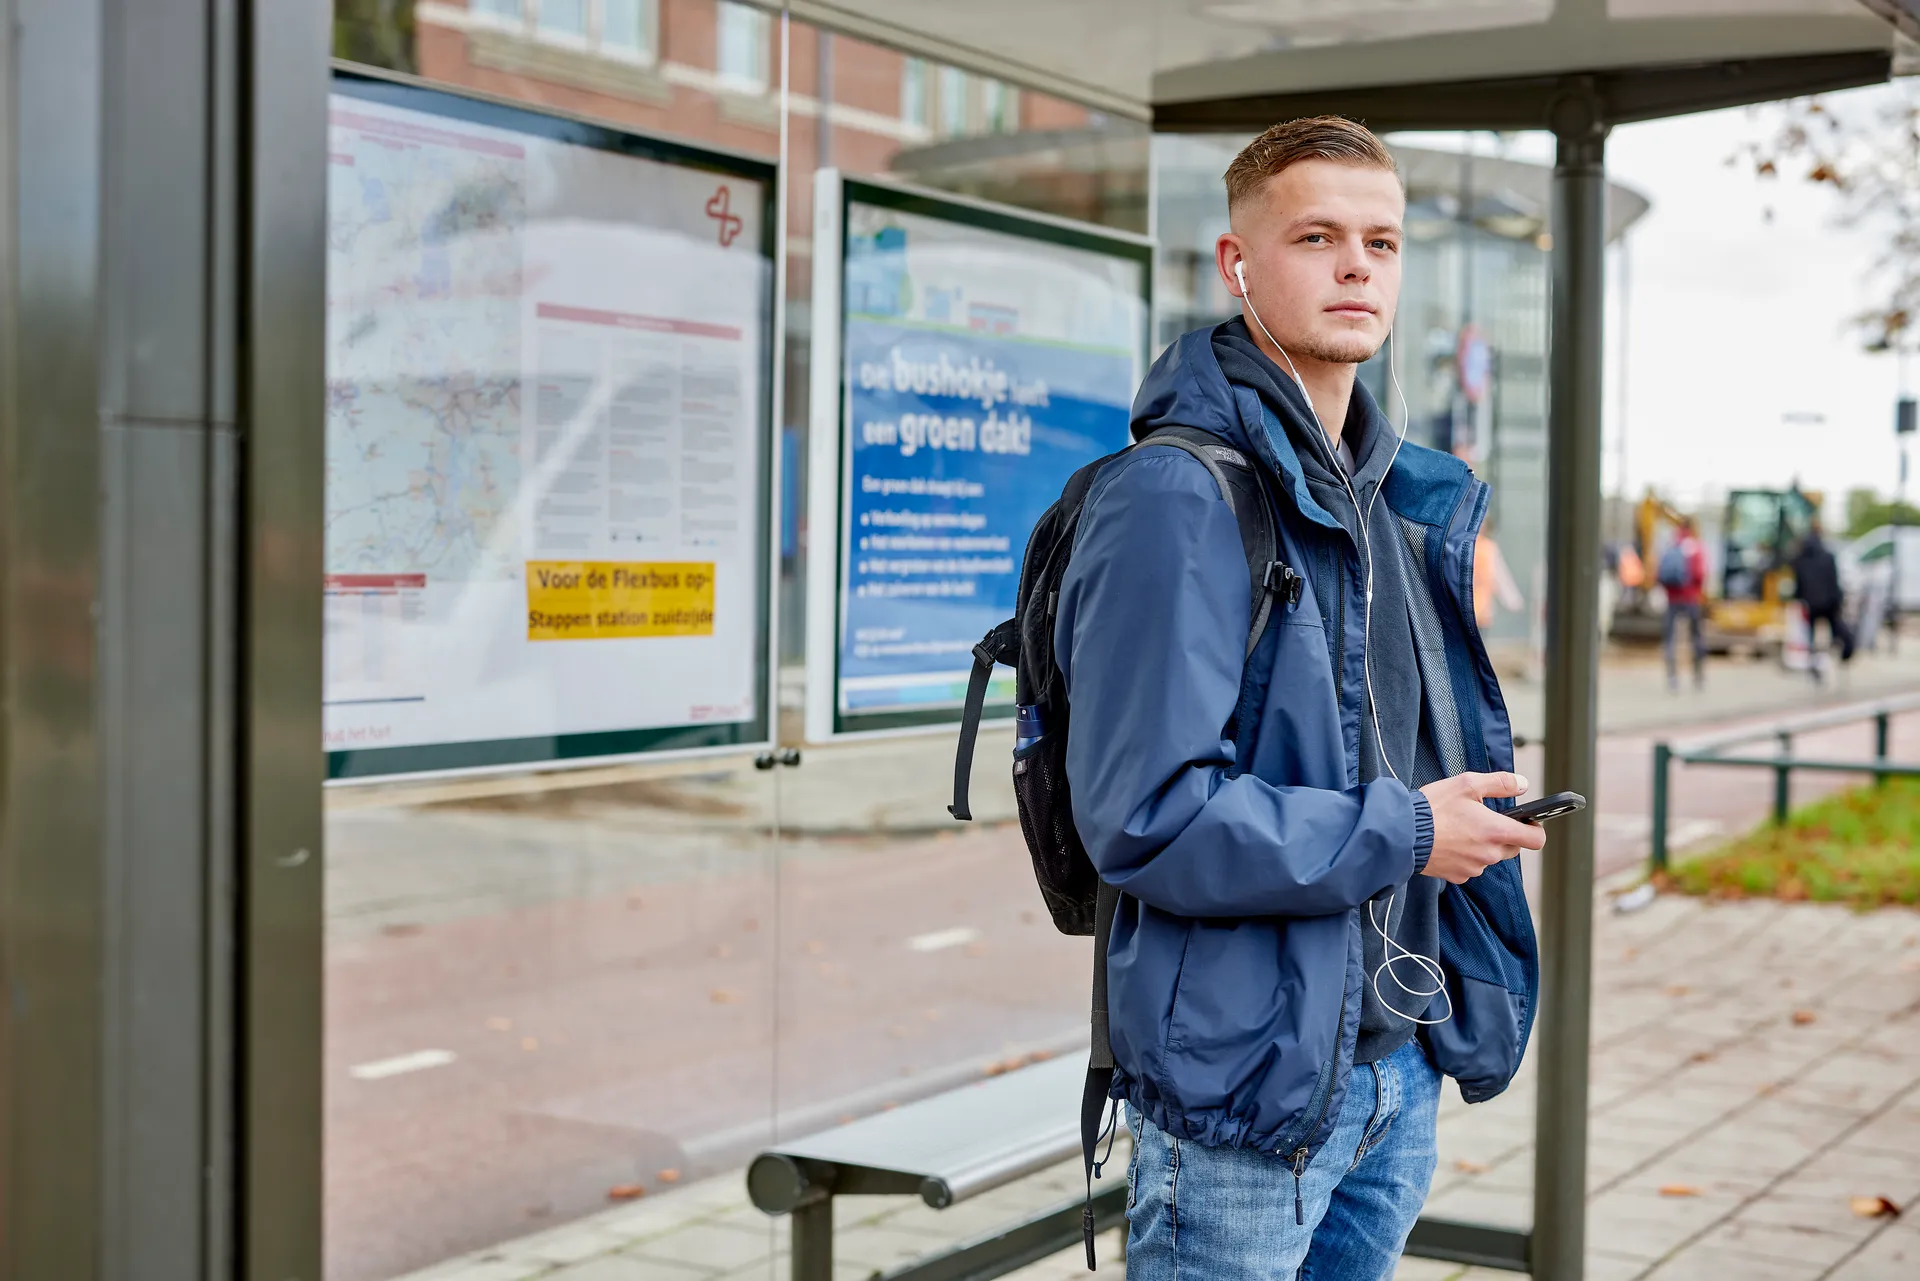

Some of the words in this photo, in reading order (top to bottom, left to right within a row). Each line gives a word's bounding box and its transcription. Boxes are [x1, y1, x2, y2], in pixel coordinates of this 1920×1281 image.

[891, 346, 1007, 410] bushokje
[863, 421, 898, 446] een
[899, 412, 976, 457] groen
[979, 409, 1032, 457] dak!
[537, 569, 581, 589] Voor
[587, 569, 607, 589] de
[613, 569, 680, 589] Flexbus
[528, 610, 592, 630] Stappen
[597, 609, 648, 627] station
